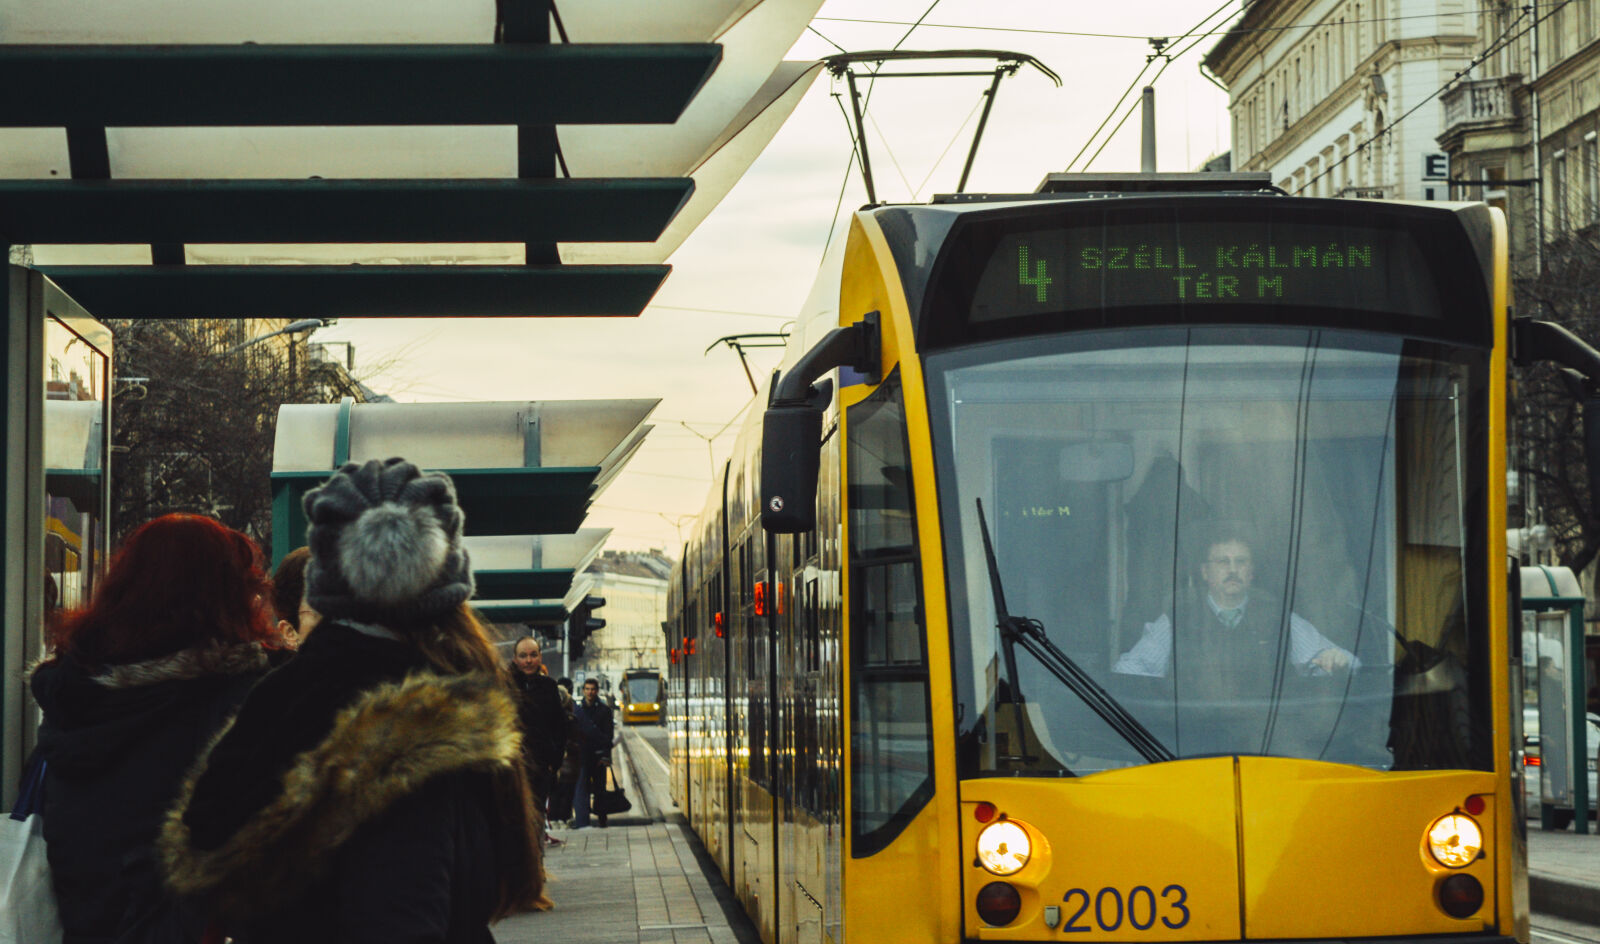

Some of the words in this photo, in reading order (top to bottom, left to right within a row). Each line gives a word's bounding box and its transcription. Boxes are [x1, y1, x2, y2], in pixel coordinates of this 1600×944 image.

[1018, 245, 1052, 302] 4
[1080, 244, 1197, 269] SZÉLL
[1216, 243, 1371, 268] KÁLMÁN
[1257, 275, 1283, 298] M
[1063, 884, 1190, 933] 2003
